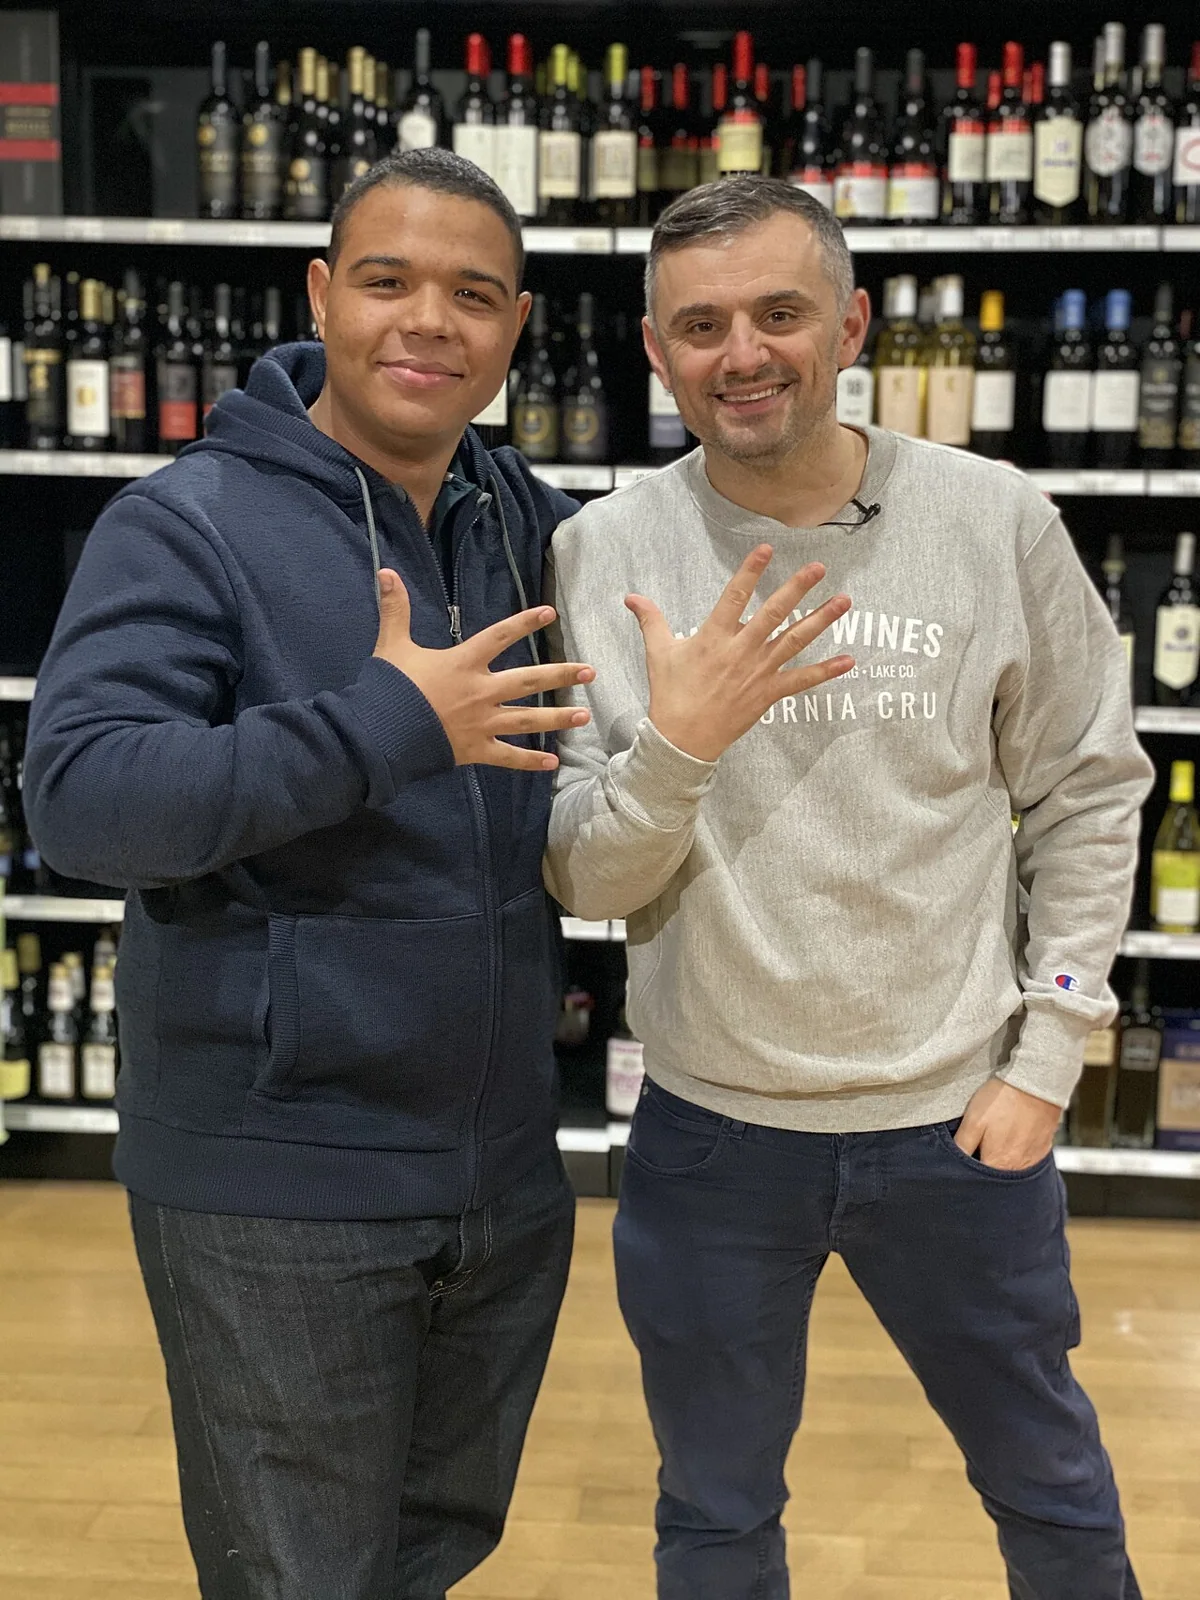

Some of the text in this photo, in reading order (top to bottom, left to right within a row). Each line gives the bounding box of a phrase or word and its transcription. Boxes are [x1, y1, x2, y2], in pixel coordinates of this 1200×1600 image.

[831, 610, 944, 658] WINES
[870, 664, 896, 678] LAKE
[898, 664, 918, 678] CO.
[877, 691, 937, 720] CRU
